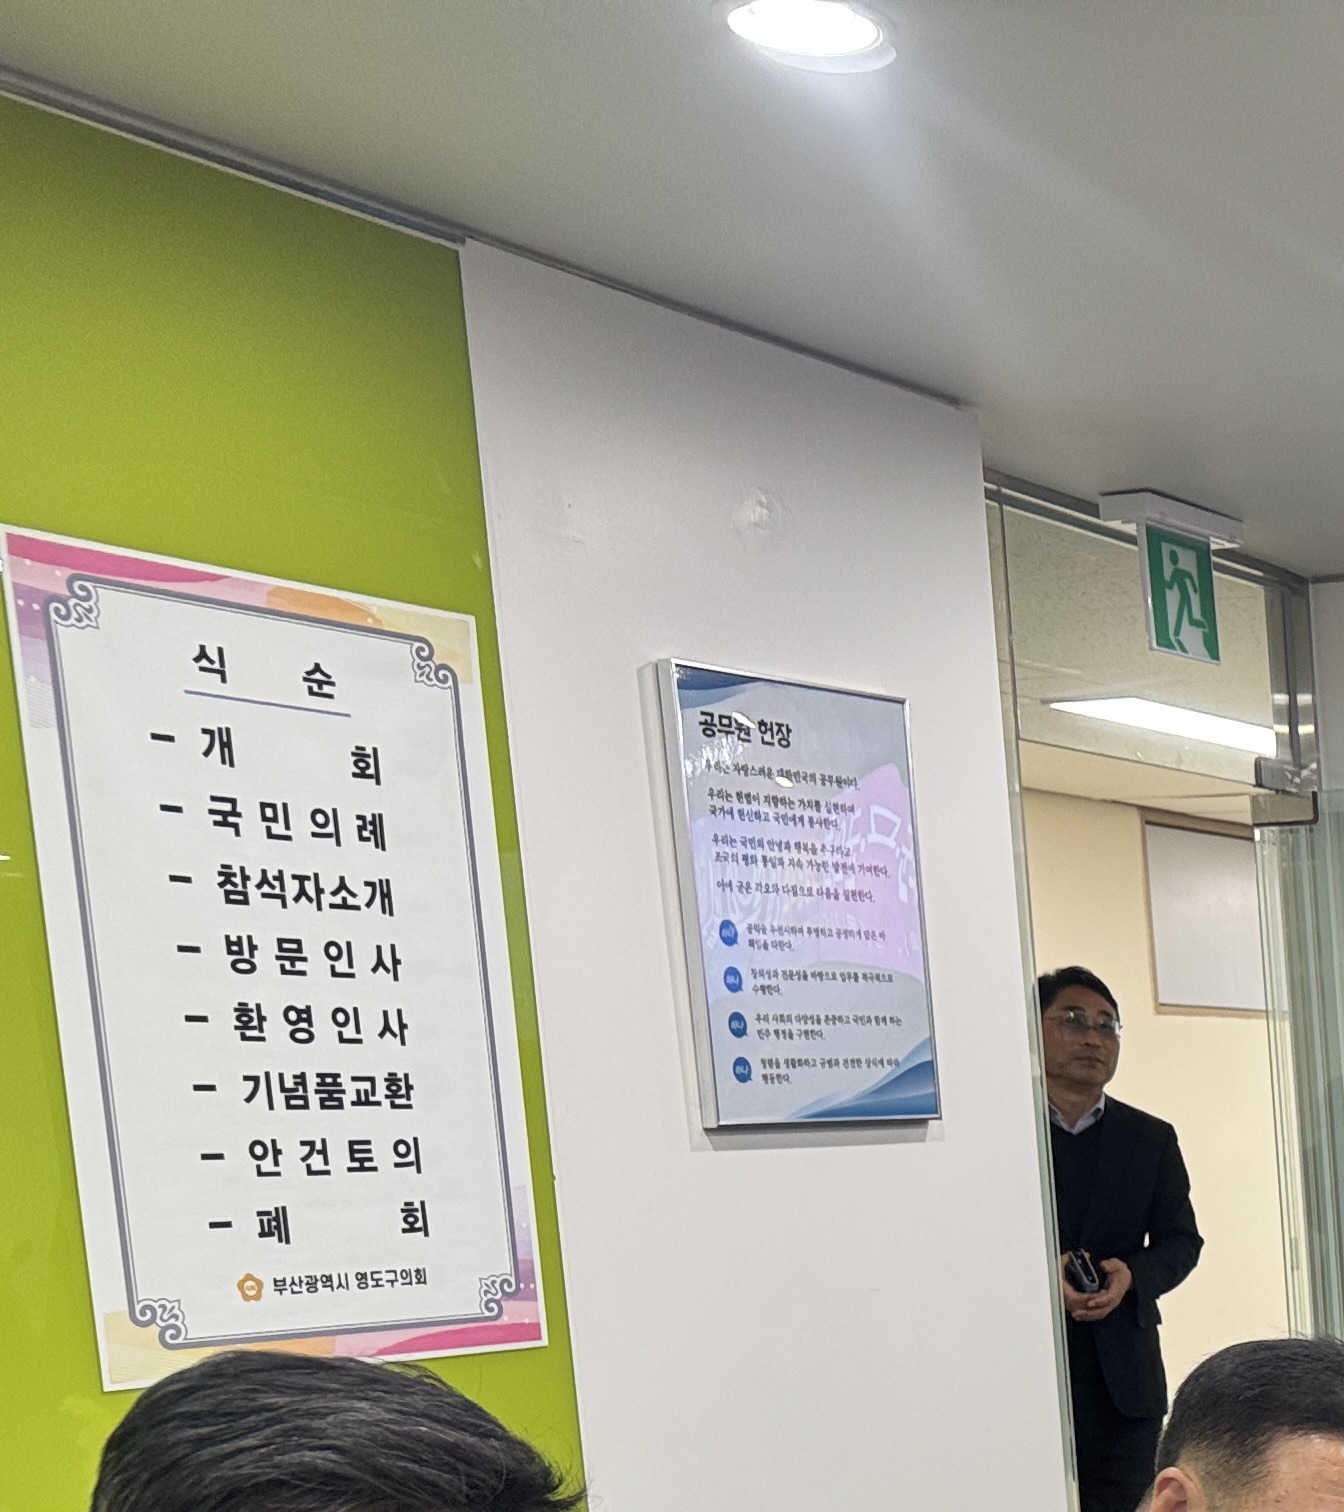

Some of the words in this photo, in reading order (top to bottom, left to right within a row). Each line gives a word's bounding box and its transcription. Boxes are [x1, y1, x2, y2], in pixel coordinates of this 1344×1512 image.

[757, 719, 793, 749] 헌장
[706, 786, 733, 803] 우리는
[711, 833, 737, 848] 우리는
[216, 864, 395, 918] 참석자소개
[242, 1071, 415, 1112] 기념품교환
[272, 1271, 350, 1297] 부산광역시
[354, 1266, 428, 1291] 영도구의회
